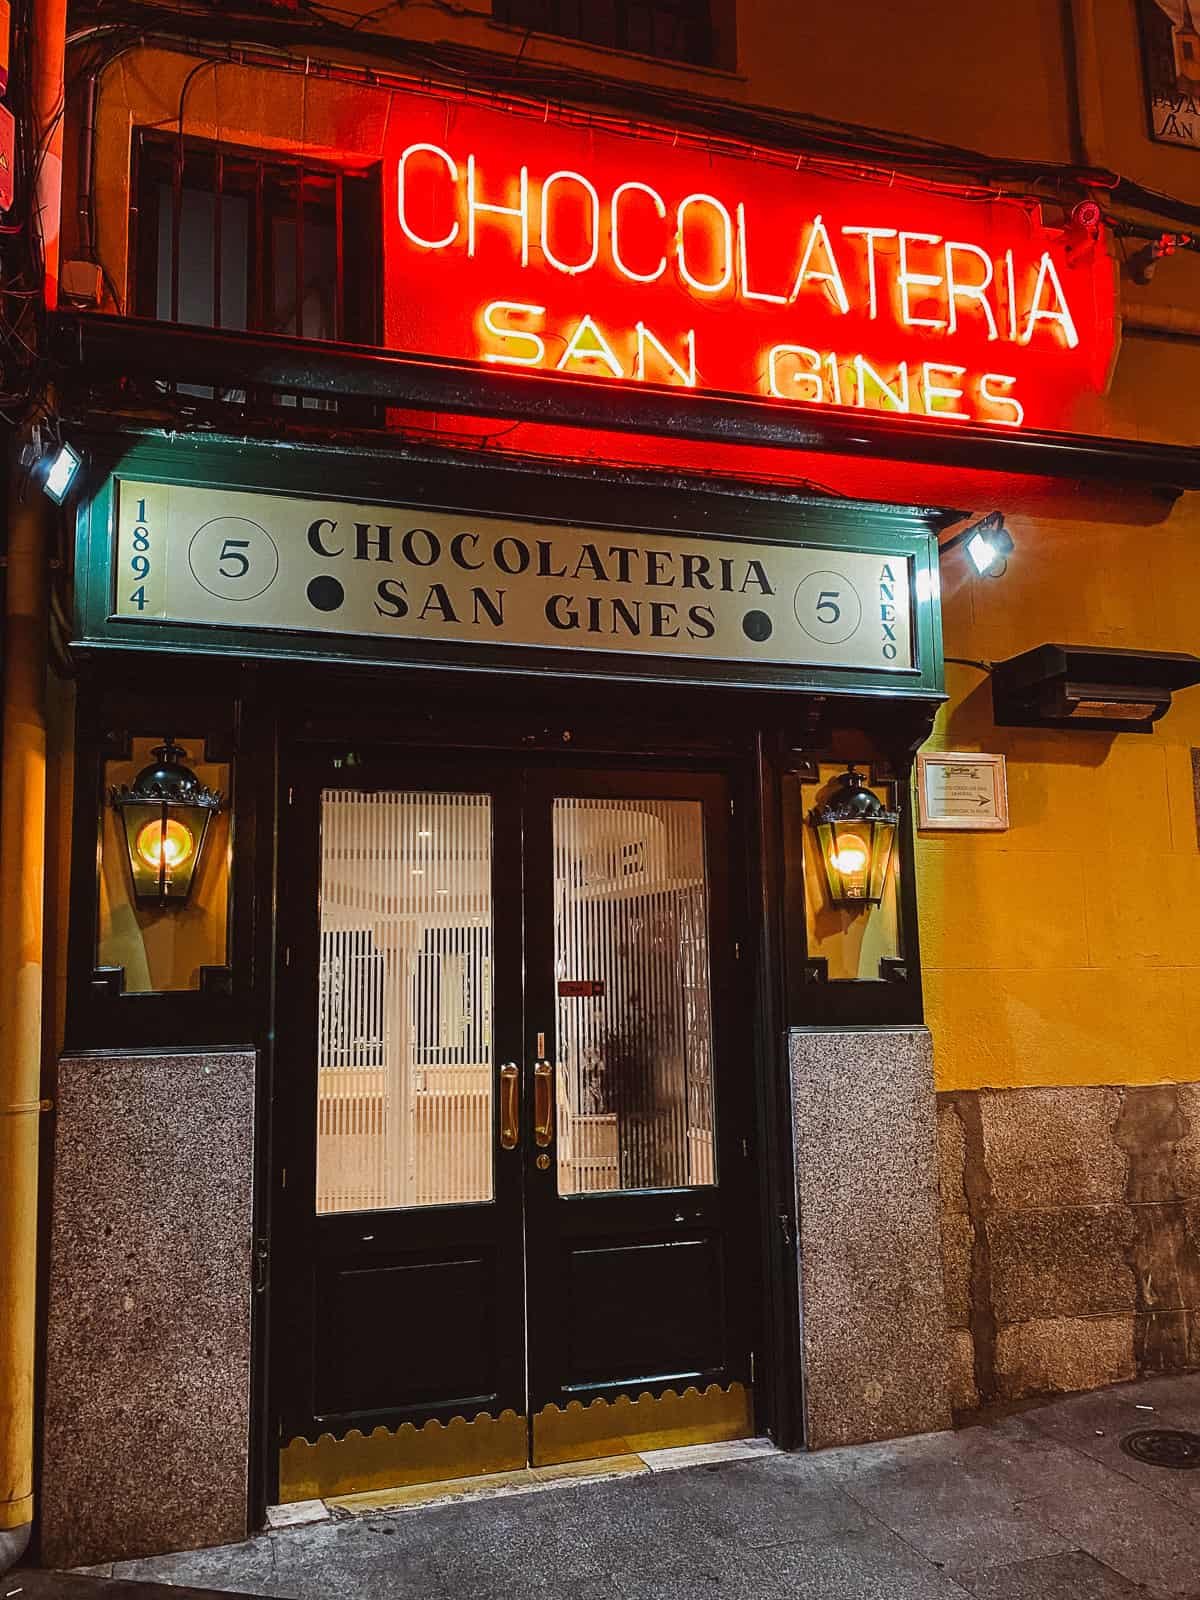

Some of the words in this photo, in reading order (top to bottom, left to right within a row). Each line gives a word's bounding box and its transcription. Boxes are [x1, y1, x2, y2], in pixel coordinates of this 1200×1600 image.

[397, 143, 1079, 349] CHOCOLATERIA
[483, 300, 697, 388] SAN
[767, 344, 1024, 427] GINES
[129, 498, 151, 611] 1894
[218, 539, 251, 579] 5
[306, 518, 777, 596] CHOCOLATERIA
[373, 578, 508, 627] SAN
[544, 593, 716, 640] GINES
[815, 591, 842, 624] 5
[878, 563, 897, 660] ANEXO
